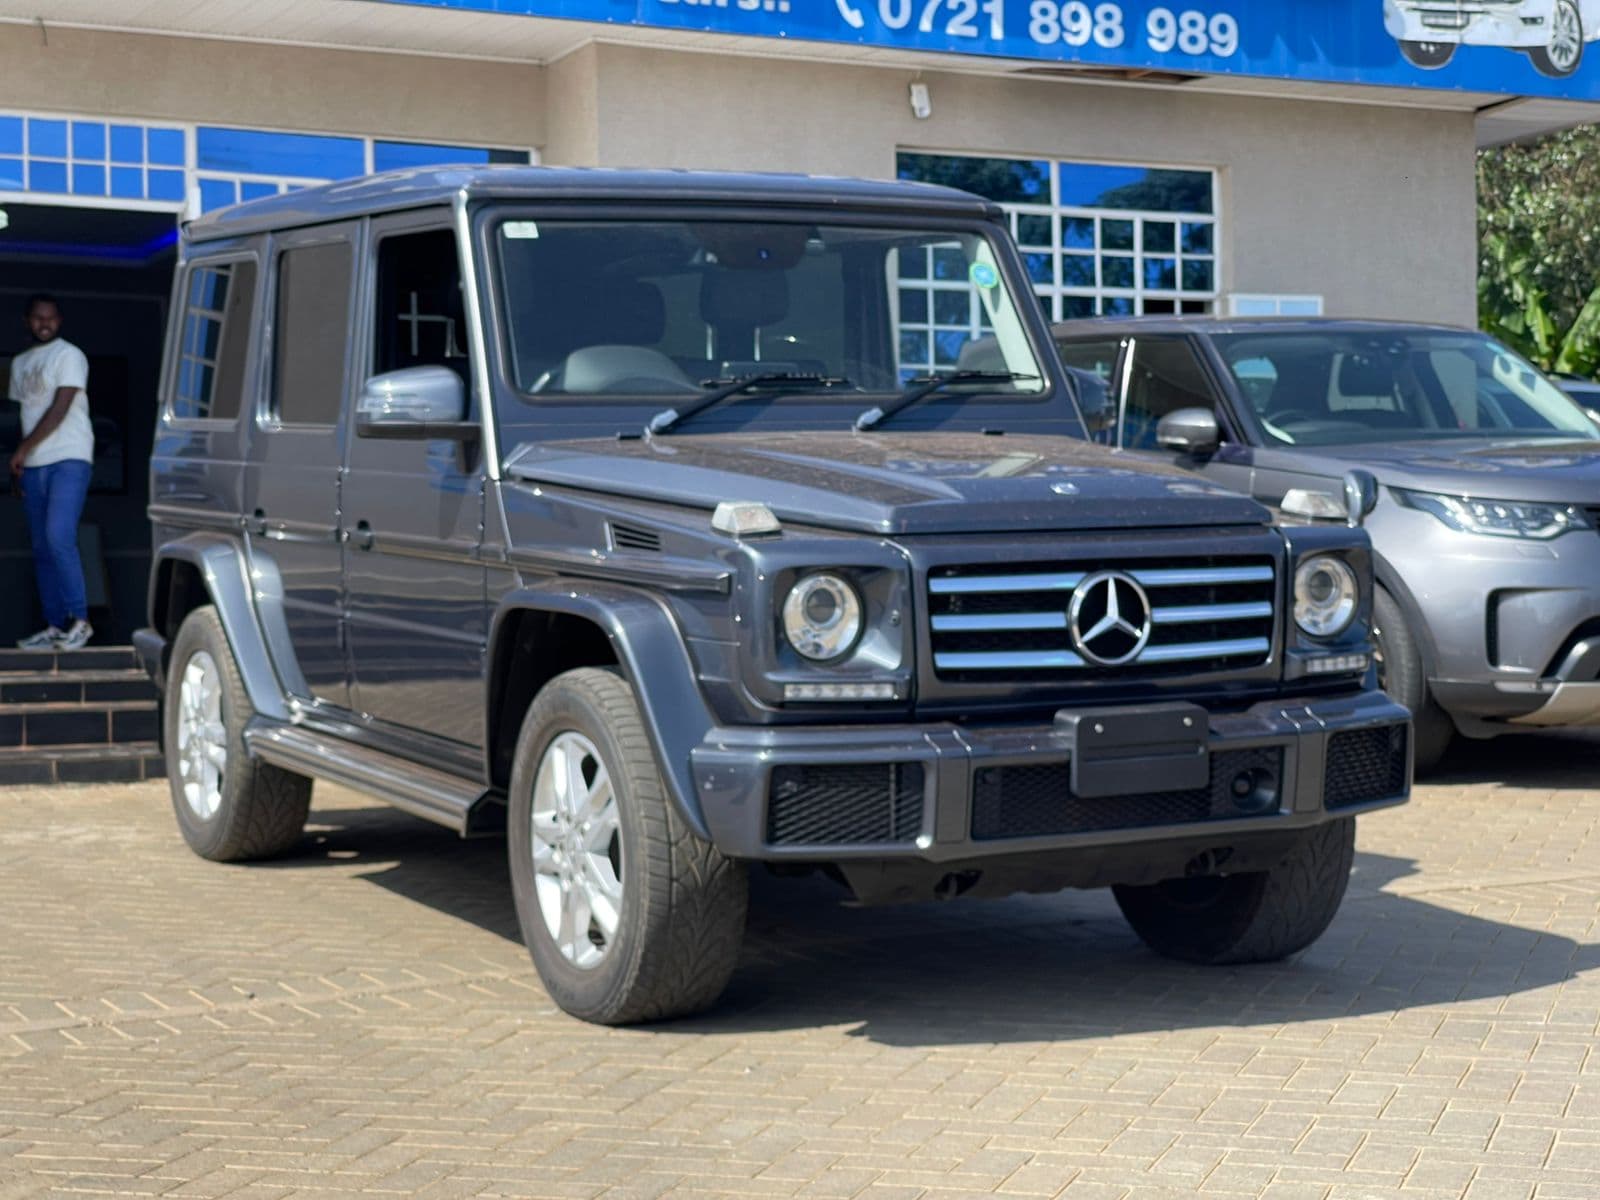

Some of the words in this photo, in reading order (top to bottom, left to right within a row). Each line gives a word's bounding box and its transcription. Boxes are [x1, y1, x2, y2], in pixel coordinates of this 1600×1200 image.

[878, 0, 1005, 41] 0721
[1028, 0, 1125, 49] 898
[1146, 6, 1239, 58] 989
